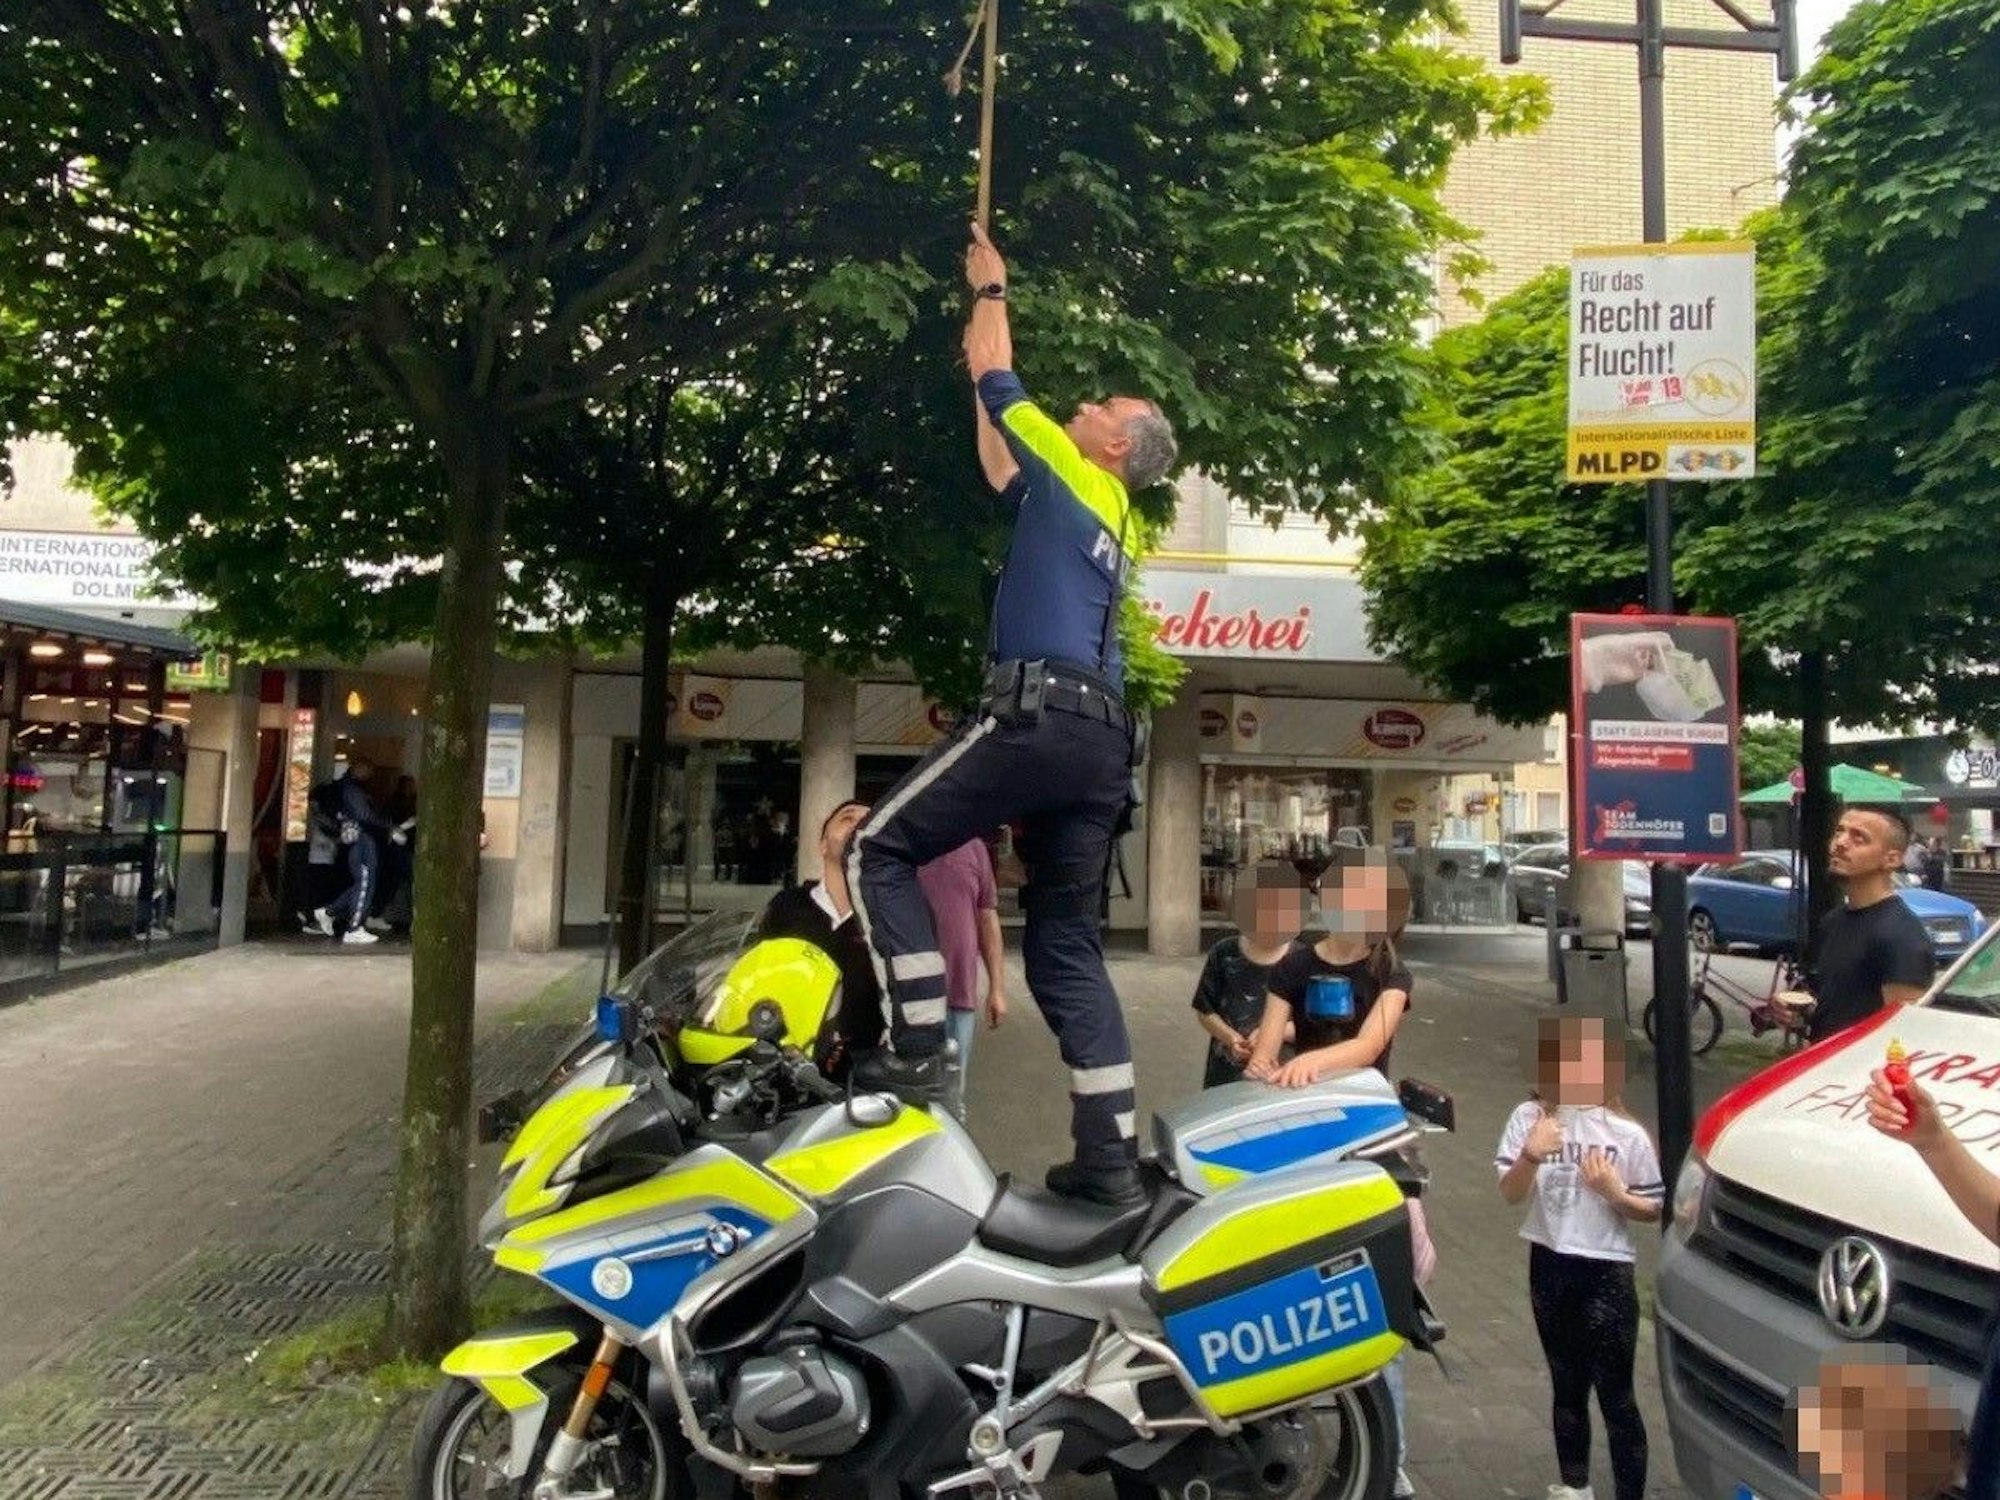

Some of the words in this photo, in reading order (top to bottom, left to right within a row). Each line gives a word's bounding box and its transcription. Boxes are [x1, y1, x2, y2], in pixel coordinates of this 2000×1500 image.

[1580, 271, 1606, 292] Für
[1611, 270, 1644, 291] das
[1580, 298, 1661, 333] Recht
[1669, 297, 1715, 331] auf
[1579, 341, 1674, 377] Flucht!
[1661, 377, 1682, 398] 13
[1576, 428, 1712, 443] Internationalistische
[1715, 428, 1748, 441] Liste
[1576, 450, 1662, 475] MLPD
[1198, 1281, 1369, 1375] POLIZEI
